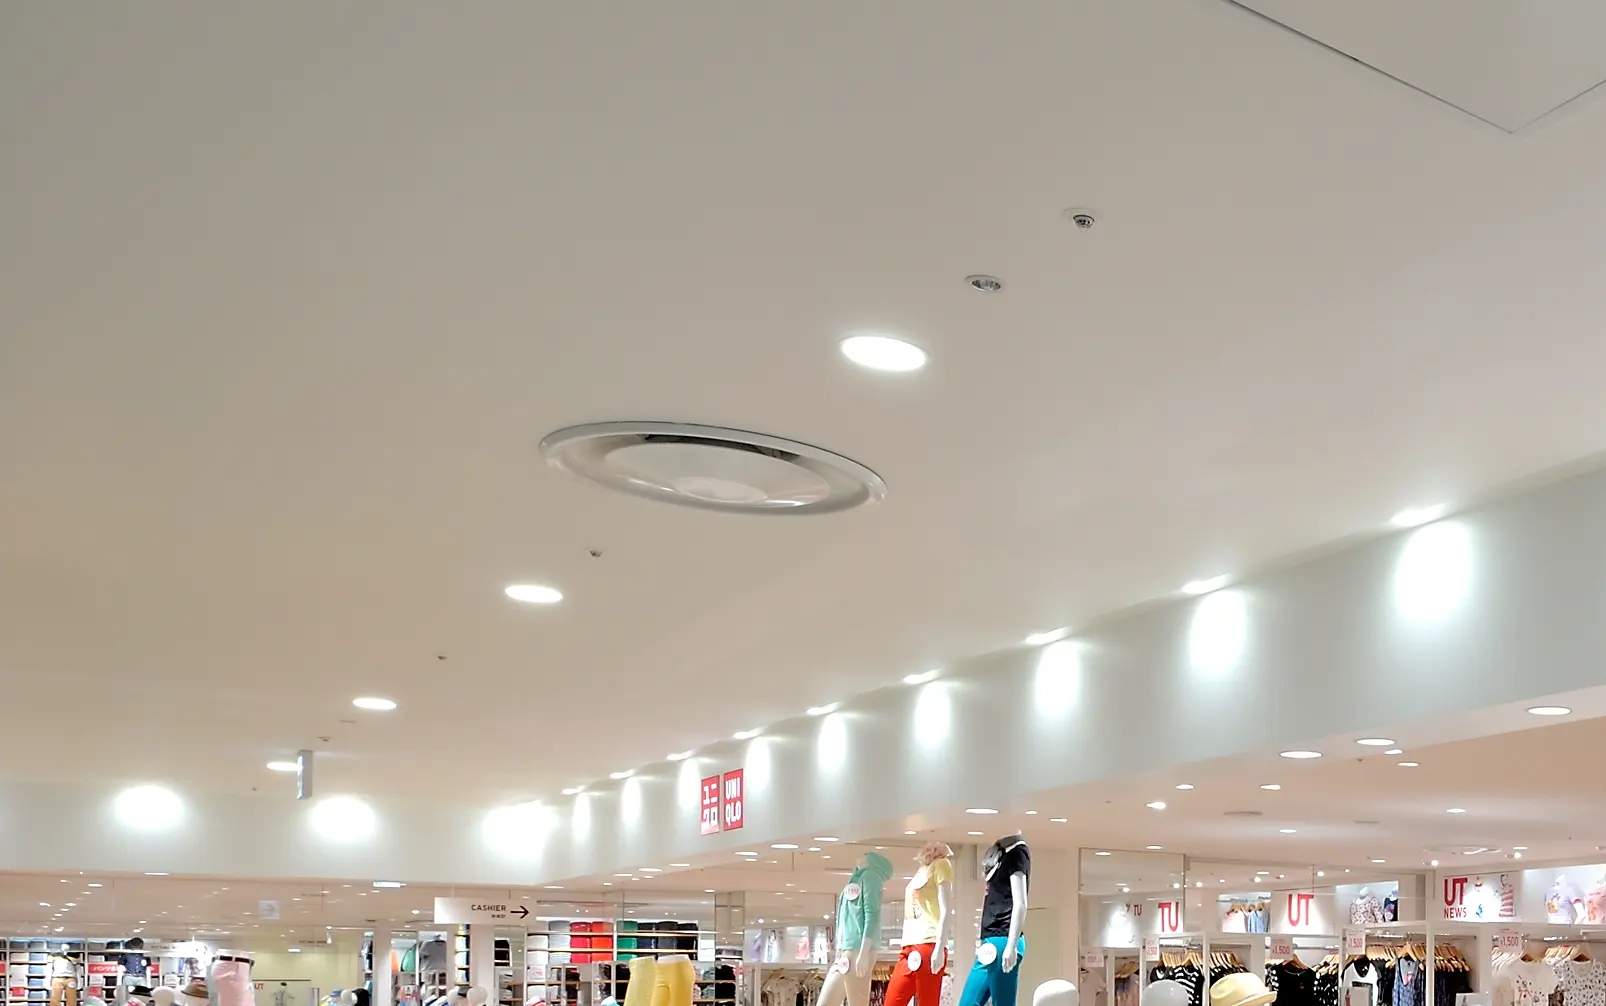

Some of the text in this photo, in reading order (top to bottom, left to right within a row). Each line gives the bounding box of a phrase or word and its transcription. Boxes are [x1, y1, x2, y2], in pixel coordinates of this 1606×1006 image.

[702, 783, 718, 805] ユニ
[725, 776, 741, 800] UNI
[725, 800, 742, 827] QLO
[1443, 877, 1468, 906] UT
[1287, 893, 1315, 927] UT
[1443, 908, 1467, 919] NEWS
